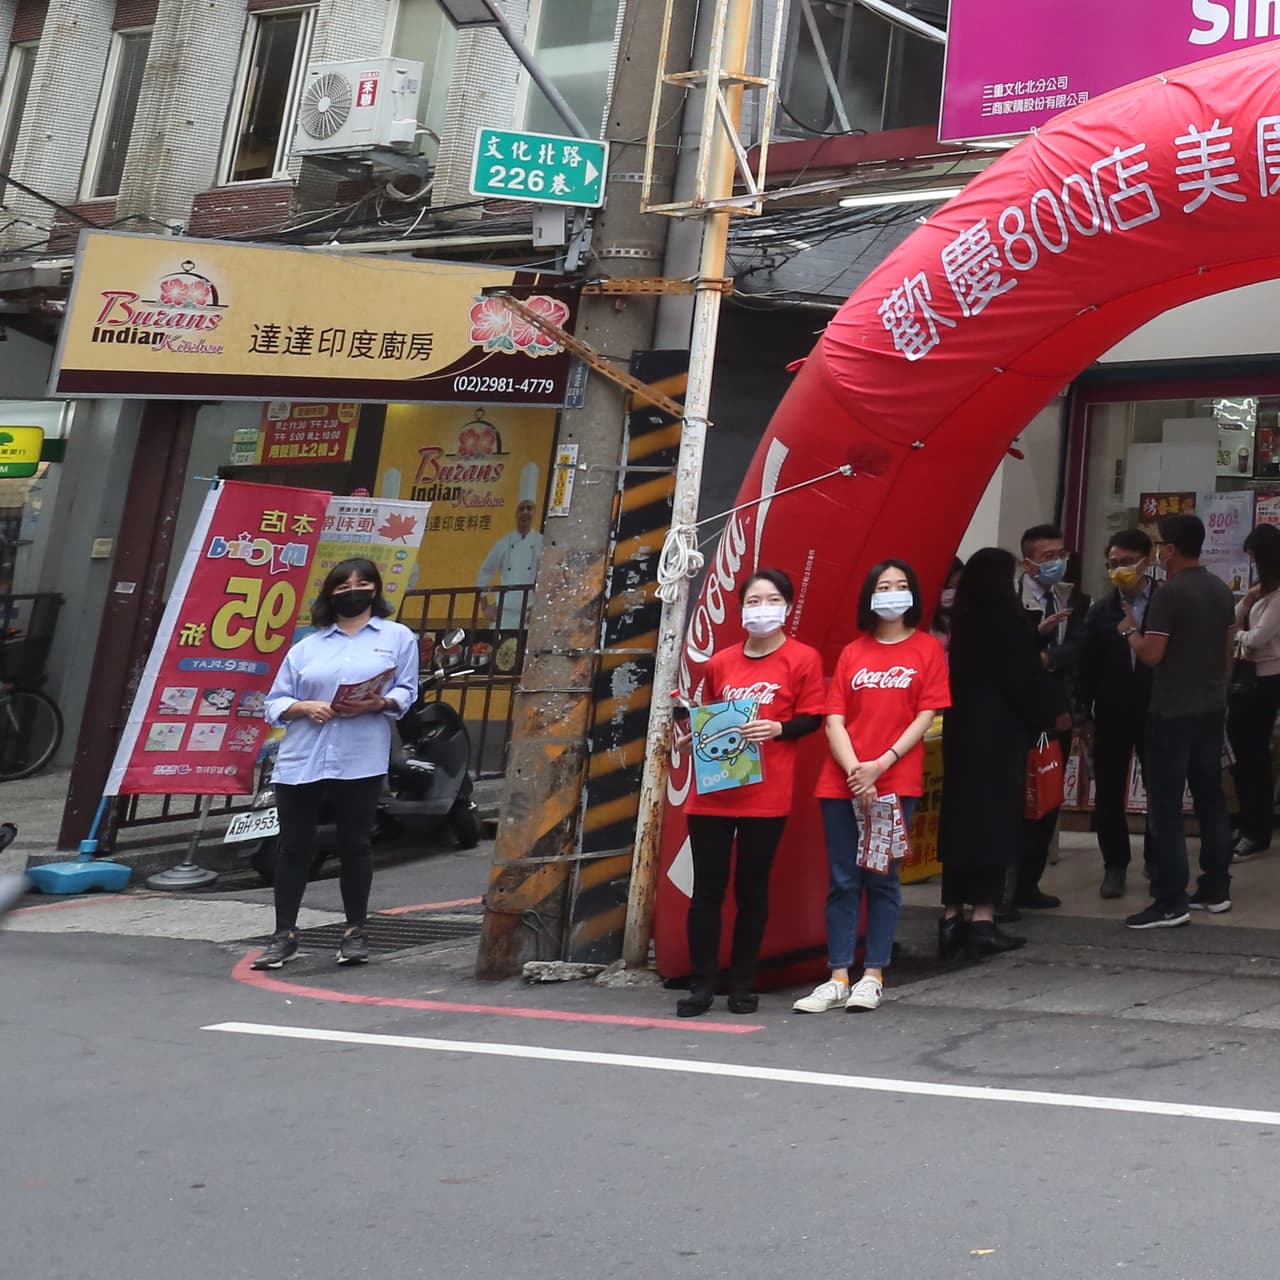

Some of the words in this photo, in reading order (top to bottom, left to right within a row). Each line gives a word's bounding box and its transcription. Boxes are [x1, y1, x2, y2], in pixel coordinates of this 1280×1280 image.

[982, 75, 1069, 99] 三重文化北分公司
[484, 135, 583, 168] 文化北路
[91, 326, 165, 346] Indian
[248, 322, 434, 363] 達達印度廚房
[453, 374, 555, 396] (02)2981-4779
[410, 485, 462, 502] Indian
[425, 515, 492, 532] 達印度料理
